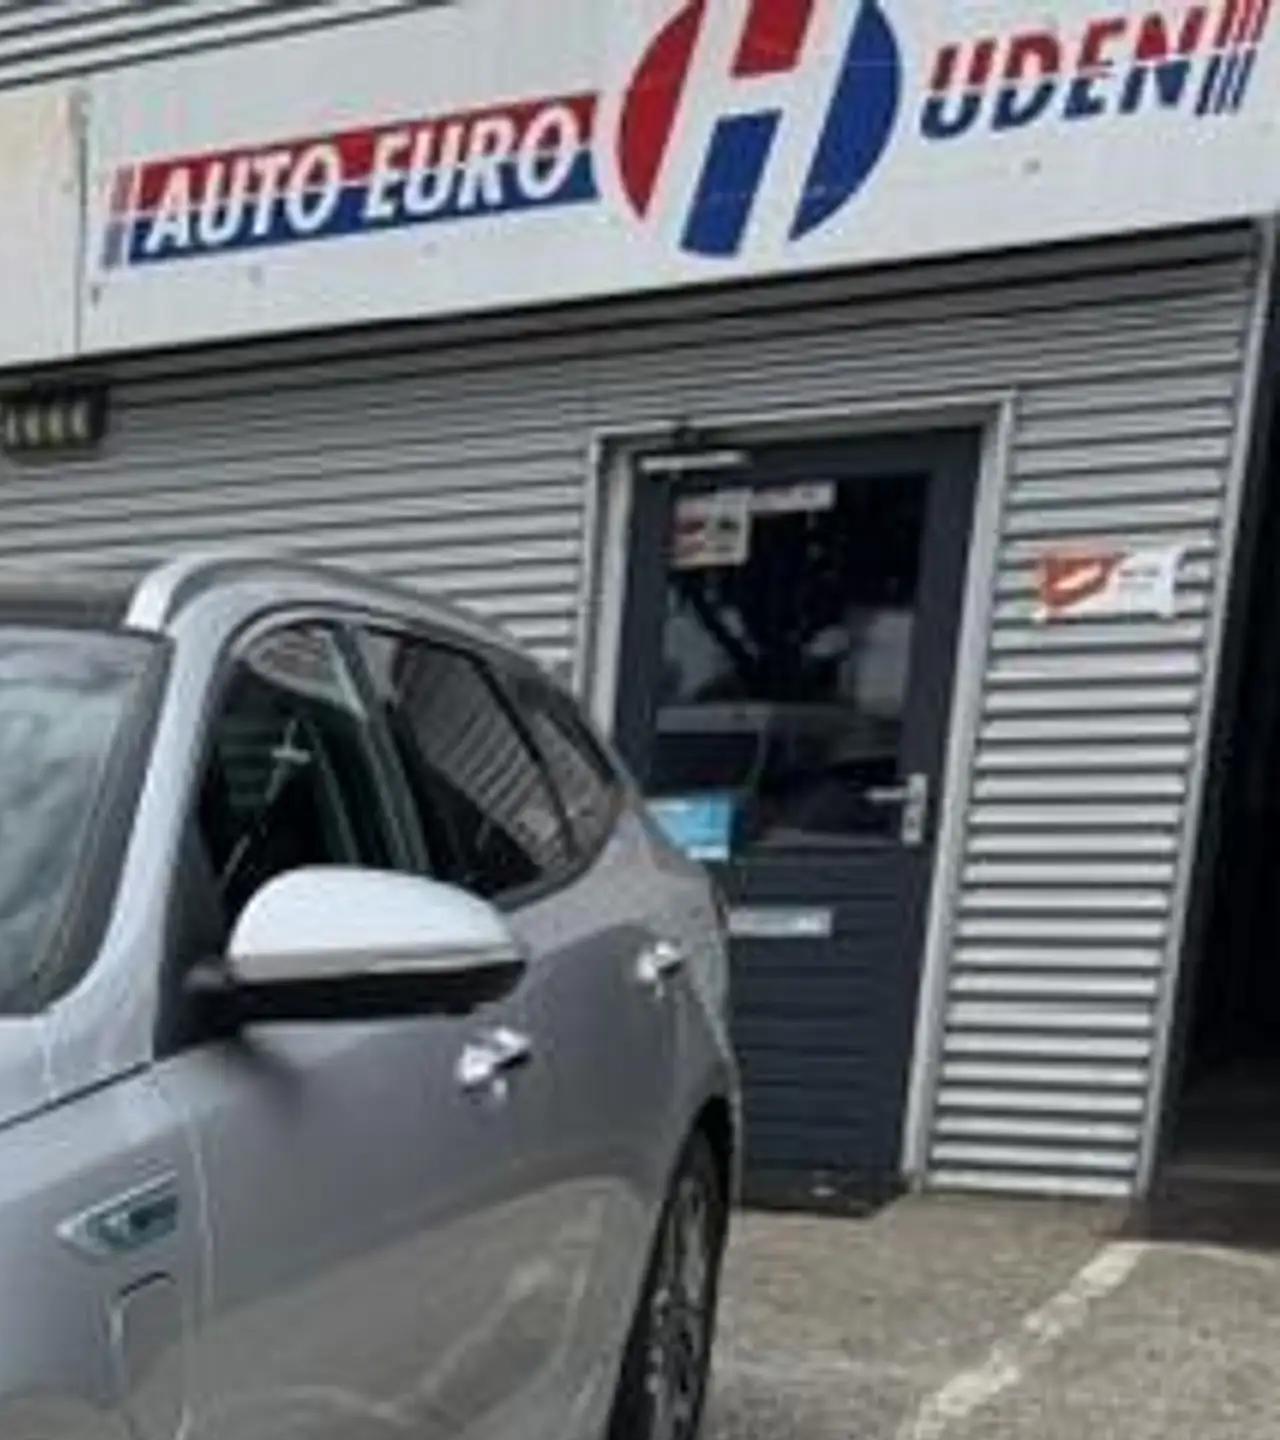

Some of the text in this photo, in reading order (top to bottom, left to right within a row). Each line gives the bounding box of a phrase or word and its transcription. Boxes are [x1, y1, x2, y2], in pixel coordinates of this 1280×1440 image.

[145, 143, 342, 253] AUTO
[361, 104, 579, 219] EURO
[919, 5, 1207, 140] UDEN
